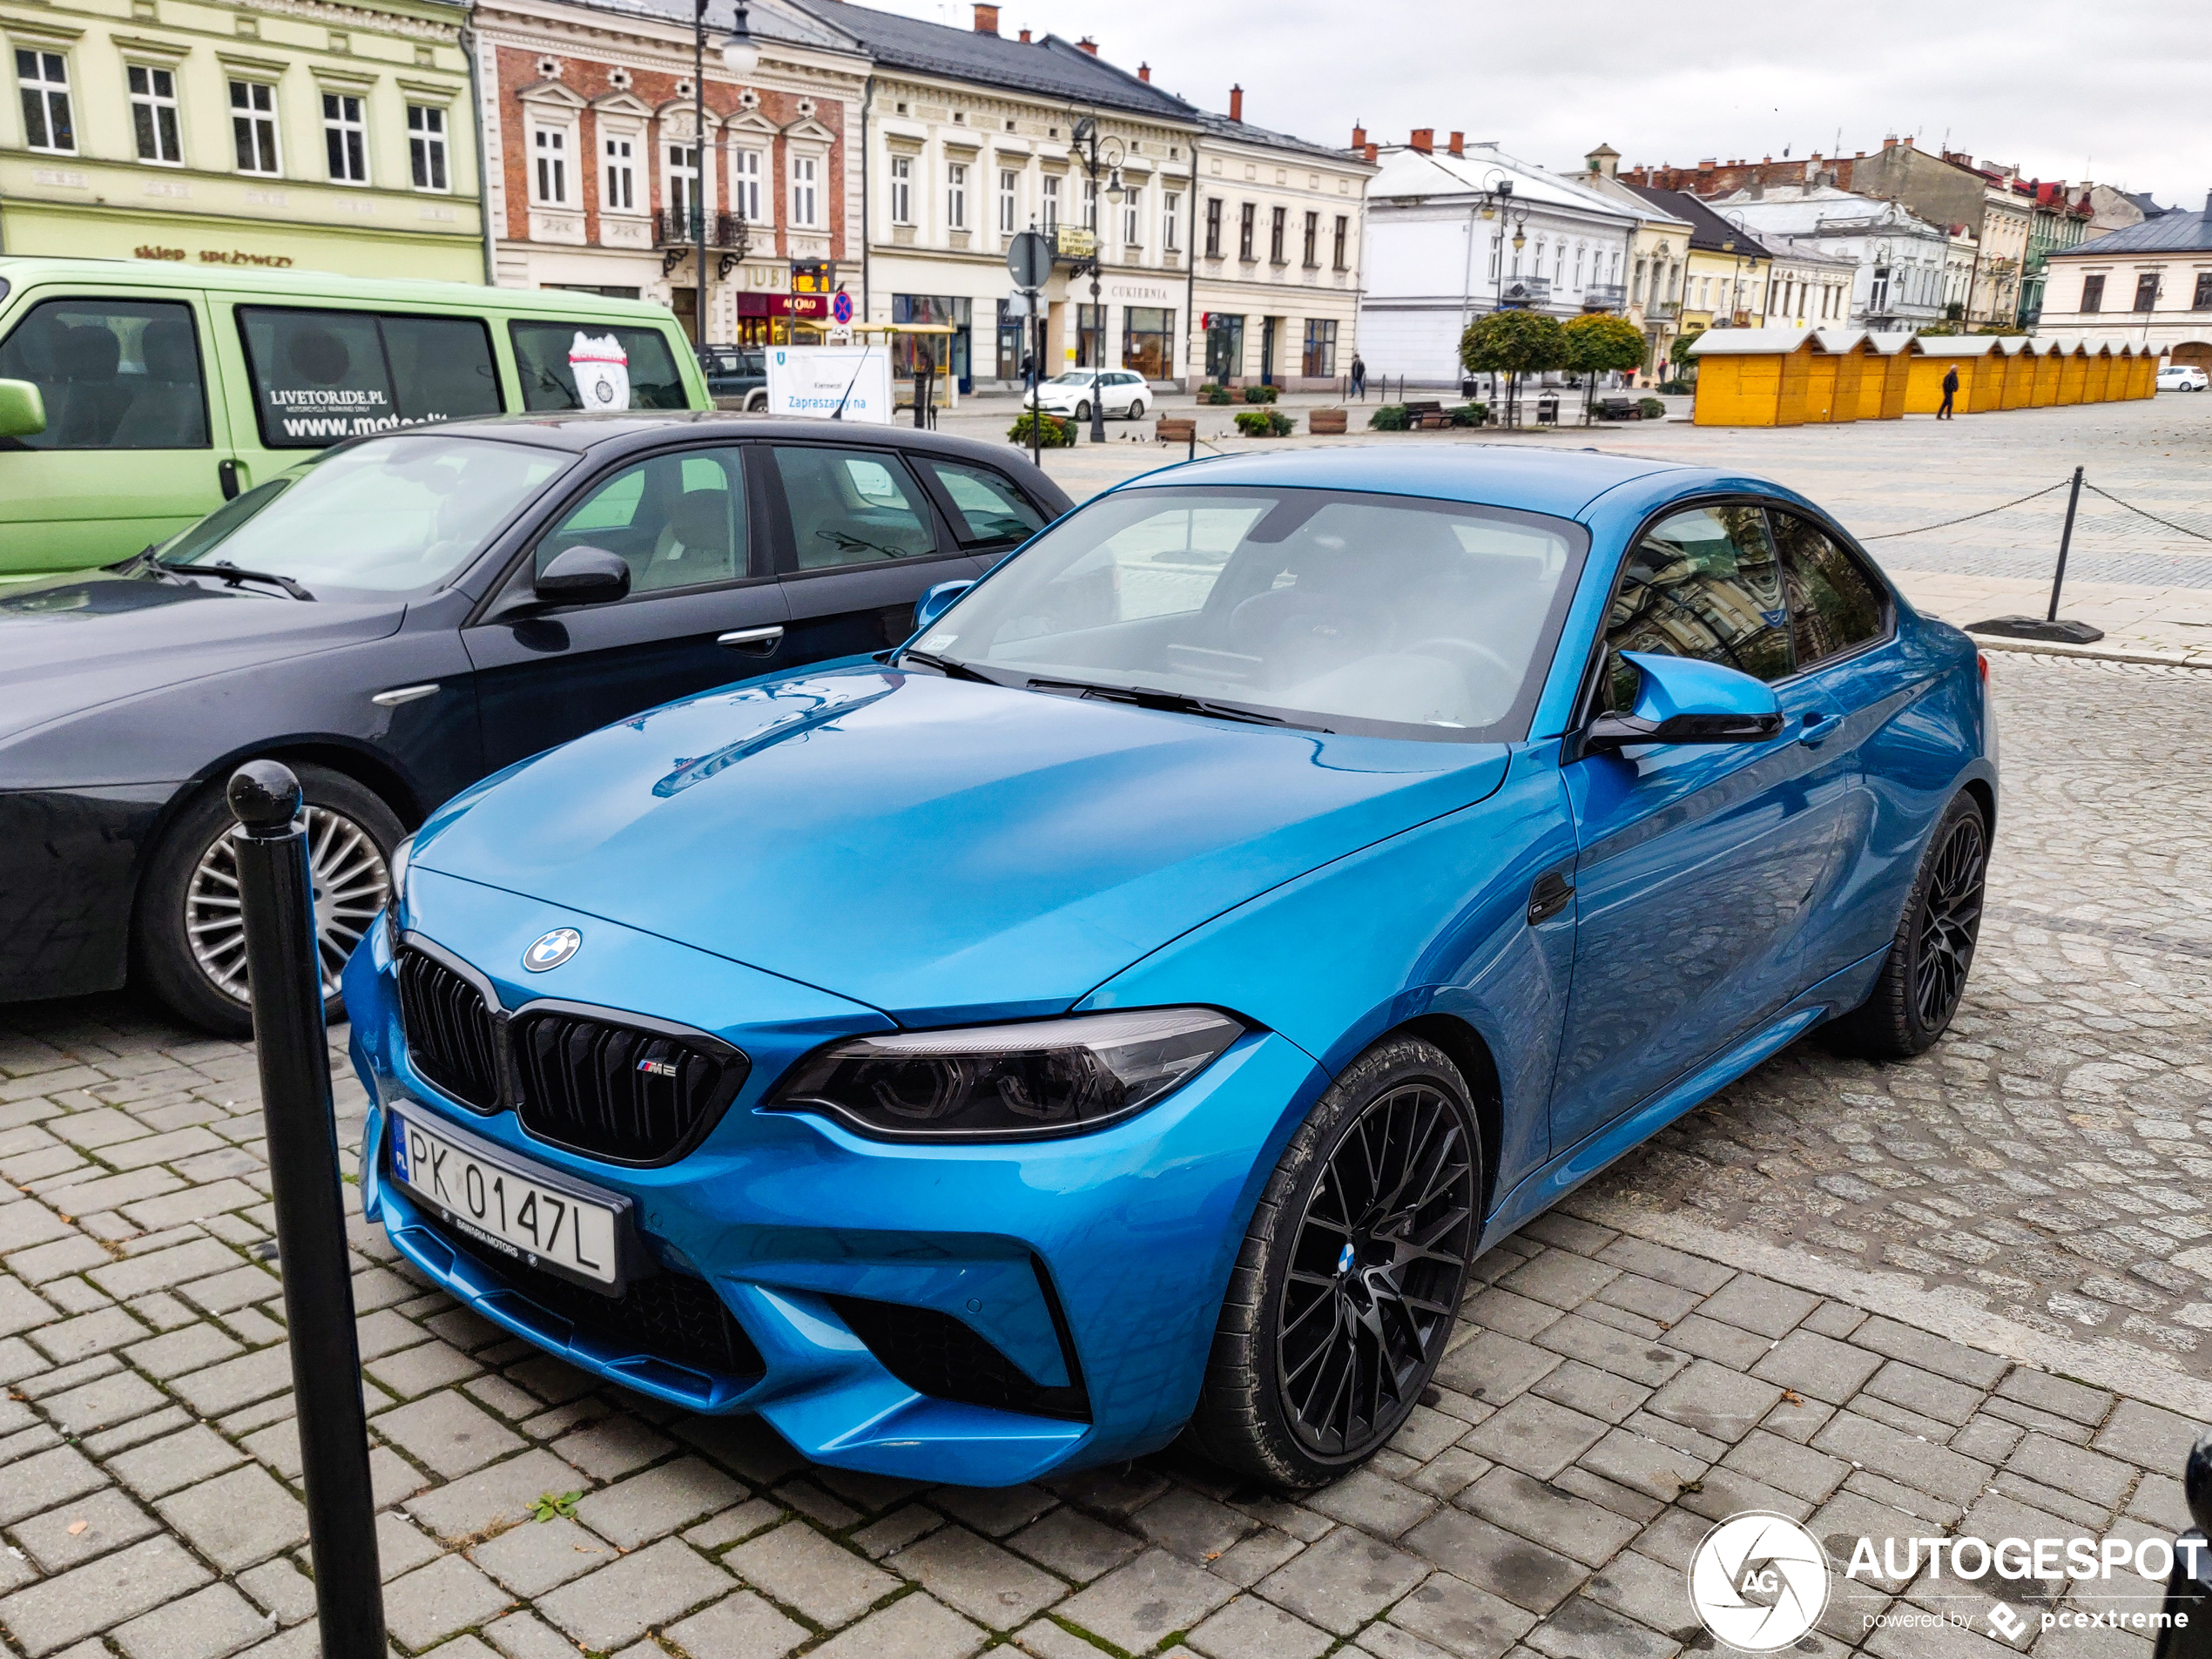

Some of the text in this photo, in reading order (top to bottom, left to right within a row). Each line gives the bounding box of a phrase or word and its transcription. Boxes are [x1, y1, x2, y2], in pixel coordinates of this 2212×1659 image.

[744, 266, 787, 291] JUBI
[1111, 286, 1167, 300] CUKIERNIA
[270, 390, 388, 405] LIVETORIDE.PL
[853, 398, 866, 408] na
[647, 1062, 676, 1077] M2
[395, 1150, 408, 1170] PL
[410, 1129, 600, 1271] PK 0147L
[455, 1218, 518, 1258] BAWARIA MOTORS
